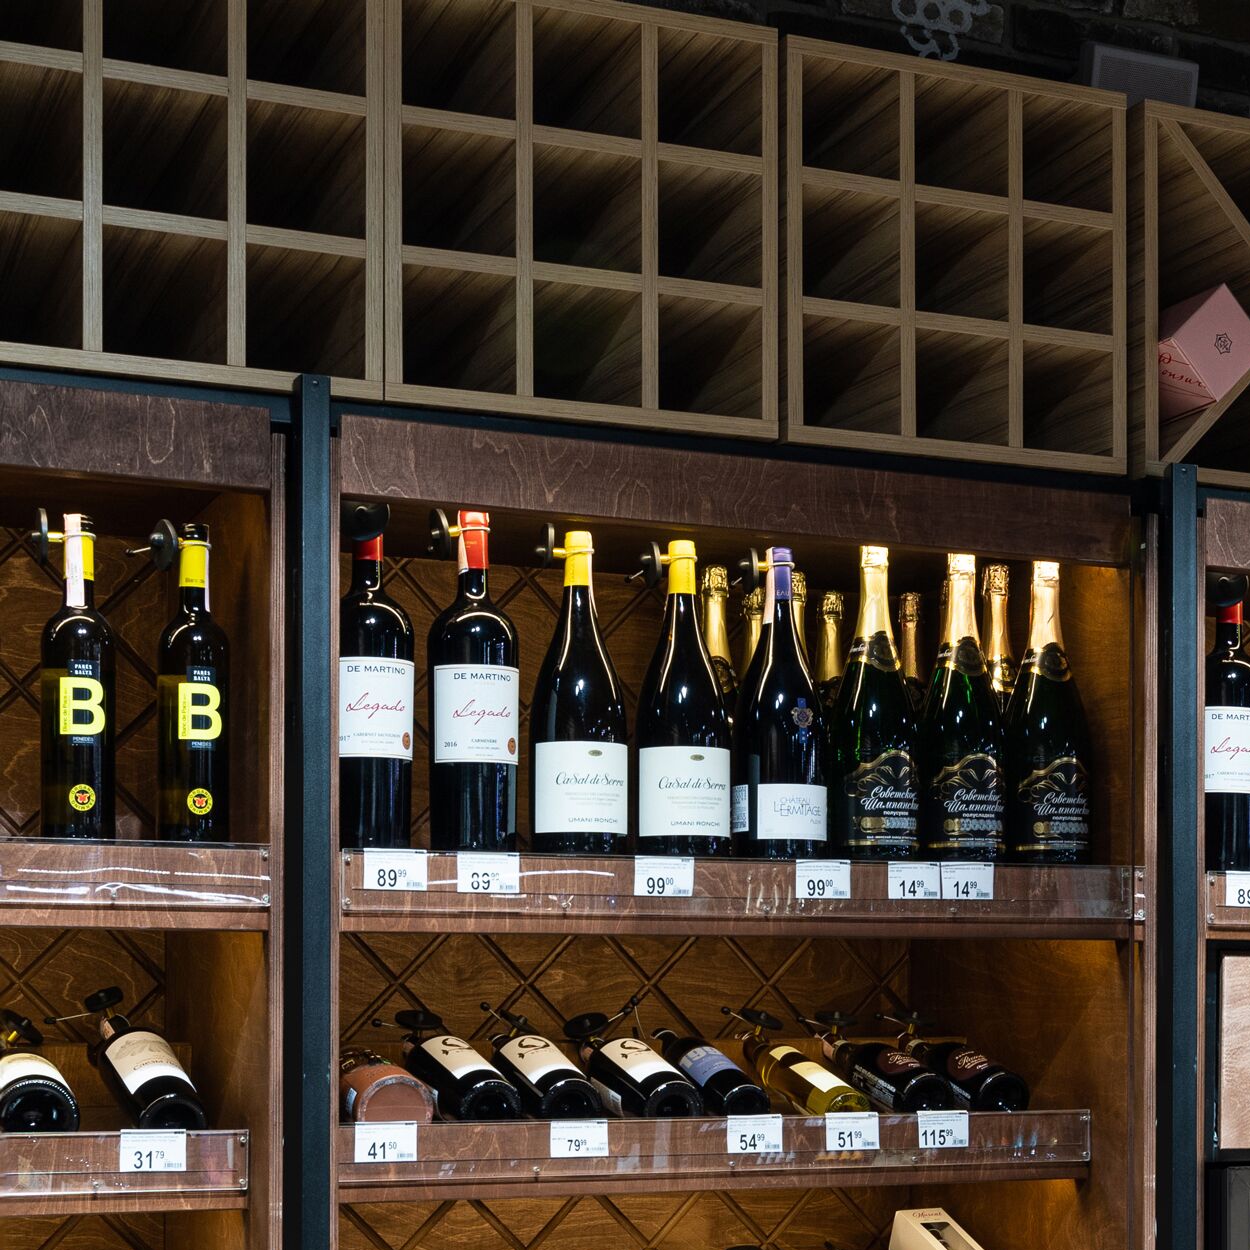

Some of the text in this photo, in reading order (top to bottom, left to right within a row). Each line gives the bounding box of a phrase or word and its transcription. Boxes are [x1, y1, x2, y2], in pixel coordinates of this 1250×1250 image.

[347, 665, 406, 675] DE MARTINO
[453, 672, 511, 682] DE MARTINO
[60, 677, 105, 735] B
[178, 682, 222, 740] B
[346, 692, 405, 719] Legado
[453, 699, 511, 725] Legado
